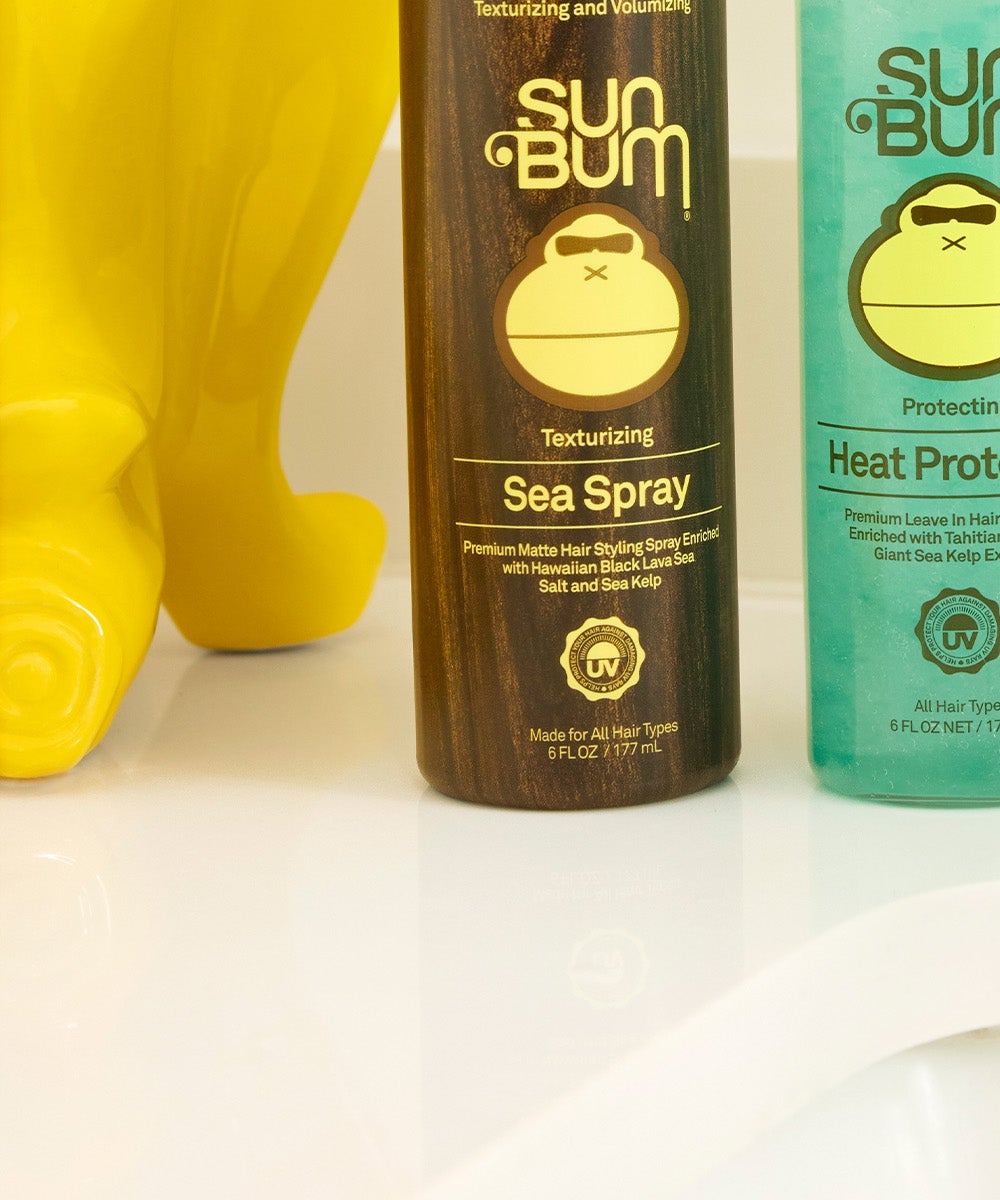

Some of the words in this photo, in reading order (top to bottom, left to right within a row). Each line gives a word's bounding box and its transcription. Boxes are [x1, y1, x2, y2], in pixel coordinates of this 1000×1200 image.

[474, 0, 570, 20] Texturizing
[574, 0, 607, 15] and
[541, 426, 654, 447] Texturizing
[830, 440, 906, 479] Heat
[504, 476, 575, 511] Sea
[584, 475, 690, 517] Spray
[845, 508, 901, 524] Premium
[906, 513, 948, 526] Leave
[953, 514, 965, 526] In
[970, 513, 1000, 525] Hair
[464, 541, 515, 556] Premium
[519, 544, 557, 556] Matte
[561, 544, 591, 556] Hair
[594, 541, 643, 558] Styling
[646, 538, 681, 553] Spray
[683, 524, 719, 545] Enriched
[850, 527, 905, 543] Enriched
[910, 532, 941, 544] with
[503, 561, 529, 574] with
[532, 562, 597, 574] Hawaiian
[601, 558, 640, 573] Black
[643, 557, 672, 569] Lava
[674, 552, 694, 565] Sea
[875, 547, 911, 561] Giant
[915, 549, 943, 562] Sea
[947, 549, 981, 565] Kelp
[540, 579, 568, 592] Salt
[571, 579, 598, 592] and
[602, 578, 628, 591] Sea
[632, 574, 661, 589] Kelp
[942, 631, 979, 651] UV
[586, 658, 621, 679] UV
[915, 700, 932, 712] All
[937, 700, 965, 713] Hair
[531, 729, 565, 741] Made
[569, 728, 588, 741] for
[591, 727, 609, 740] All
[612, 725, 641, 739] Hair
[643, 721, 679, 739] Types
[891, 719, 898, 731] 6
[902, 720, 918, 732] FL
[921, 721, 939, 733] OZ
[944, 721, 973, 733] NET
[976, 720, 982, 732] /
[549, 747, 556, 759] 6
[560, 746, 576, 759] FL
[578, 745, 598, 758] OZ
[604, 744, 610, 757] /
[614, 742, 637, 756] 177
[642, 740, 662, 753] mL
